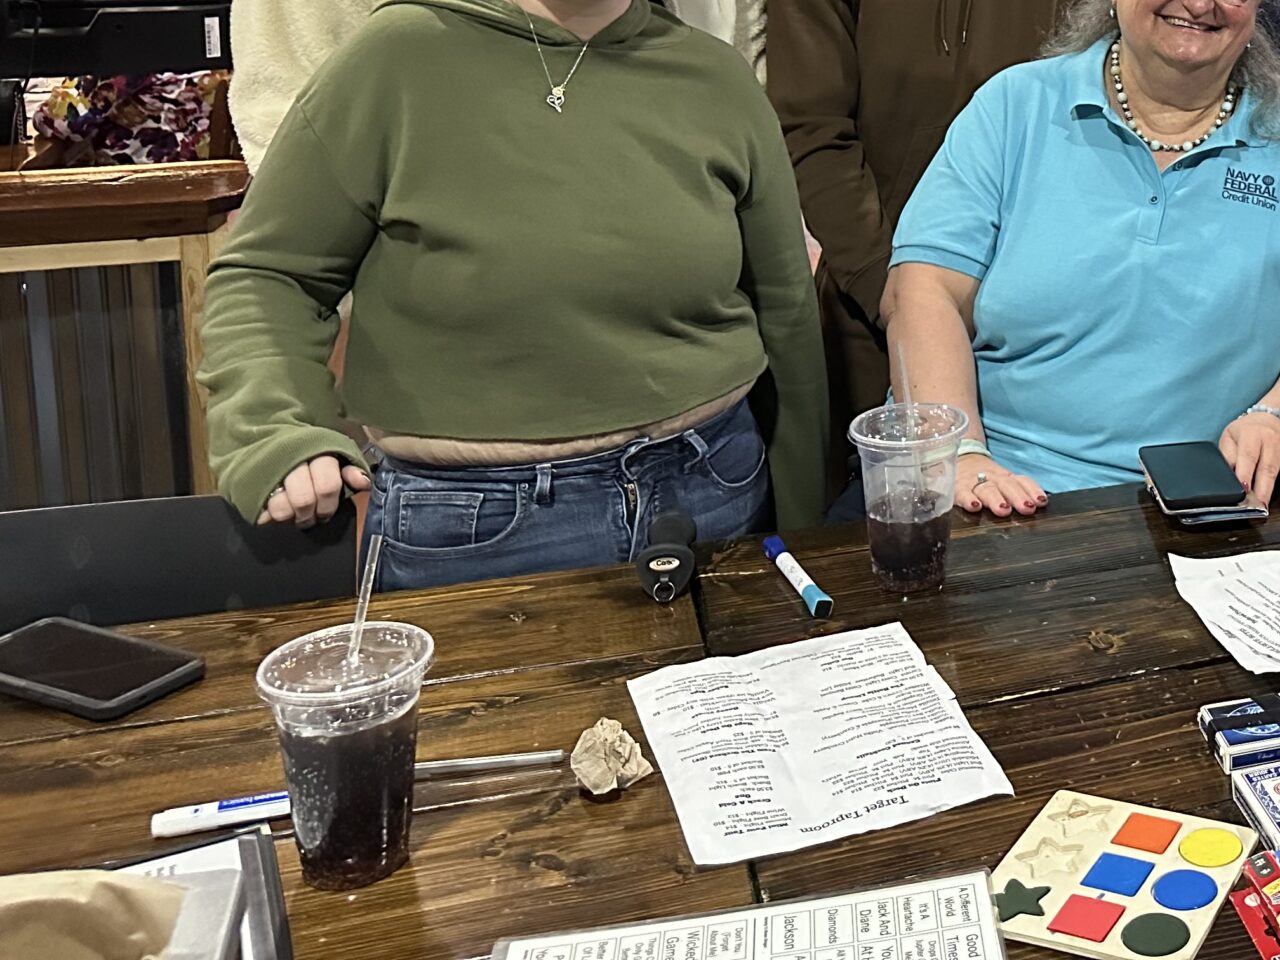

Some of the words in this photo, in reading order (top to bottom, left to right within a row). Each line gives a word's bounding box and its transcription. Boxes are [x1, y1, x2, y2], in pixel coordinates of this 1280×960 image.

[1226, 167, 1261, 184] NAVY
[1223, 177, 1278, 199] FEDERAL
[1221, 190, 1250, 204] Credit
[1251, 196, 1277, 212] Union
[865, 793, 910, 814] Target
[797, 805, 862, 835] Taproom
[877, 901, 888, 918] Jack
[903, 897, 915, 932] Heartache
[944, 897, 955, 917] World
[960, 892, 974, 922] Different
[783, 915, 796, 950] Jackson
[827, 908, 839, 944] Diamonds
[859, 909, 870, 933] Diane
[880, 919, 891, 936] And
[734, 927, 744, 941] Don't
[966, 933, 979, 958] Good
[947, 935, 959, 960] Times
